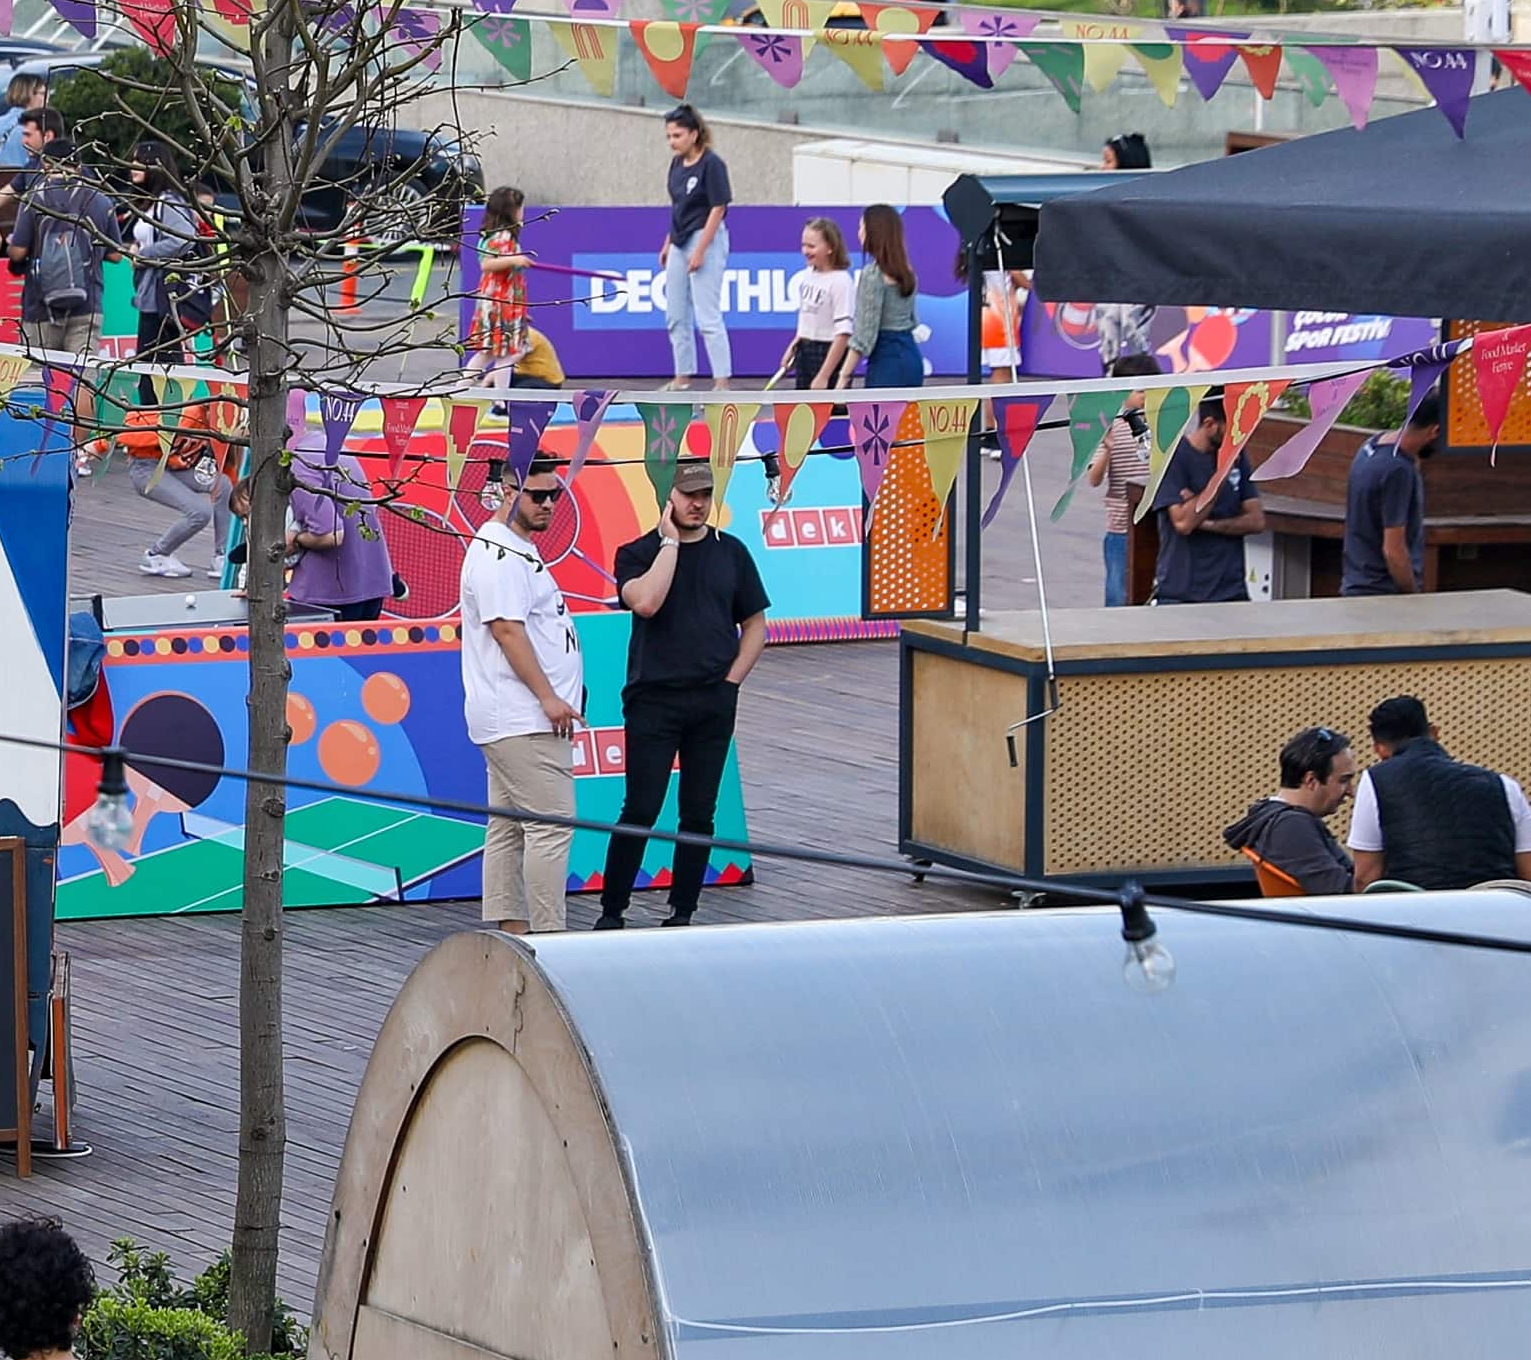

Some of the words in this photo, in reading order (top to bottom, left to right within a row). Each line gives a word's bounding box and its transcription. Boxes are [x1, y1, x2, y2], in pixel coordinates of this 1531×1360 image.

[325, 396, 355, 423] NO.44
[928, 405, 968, 433] NO.44
[770, 516, 846, 539] dek
